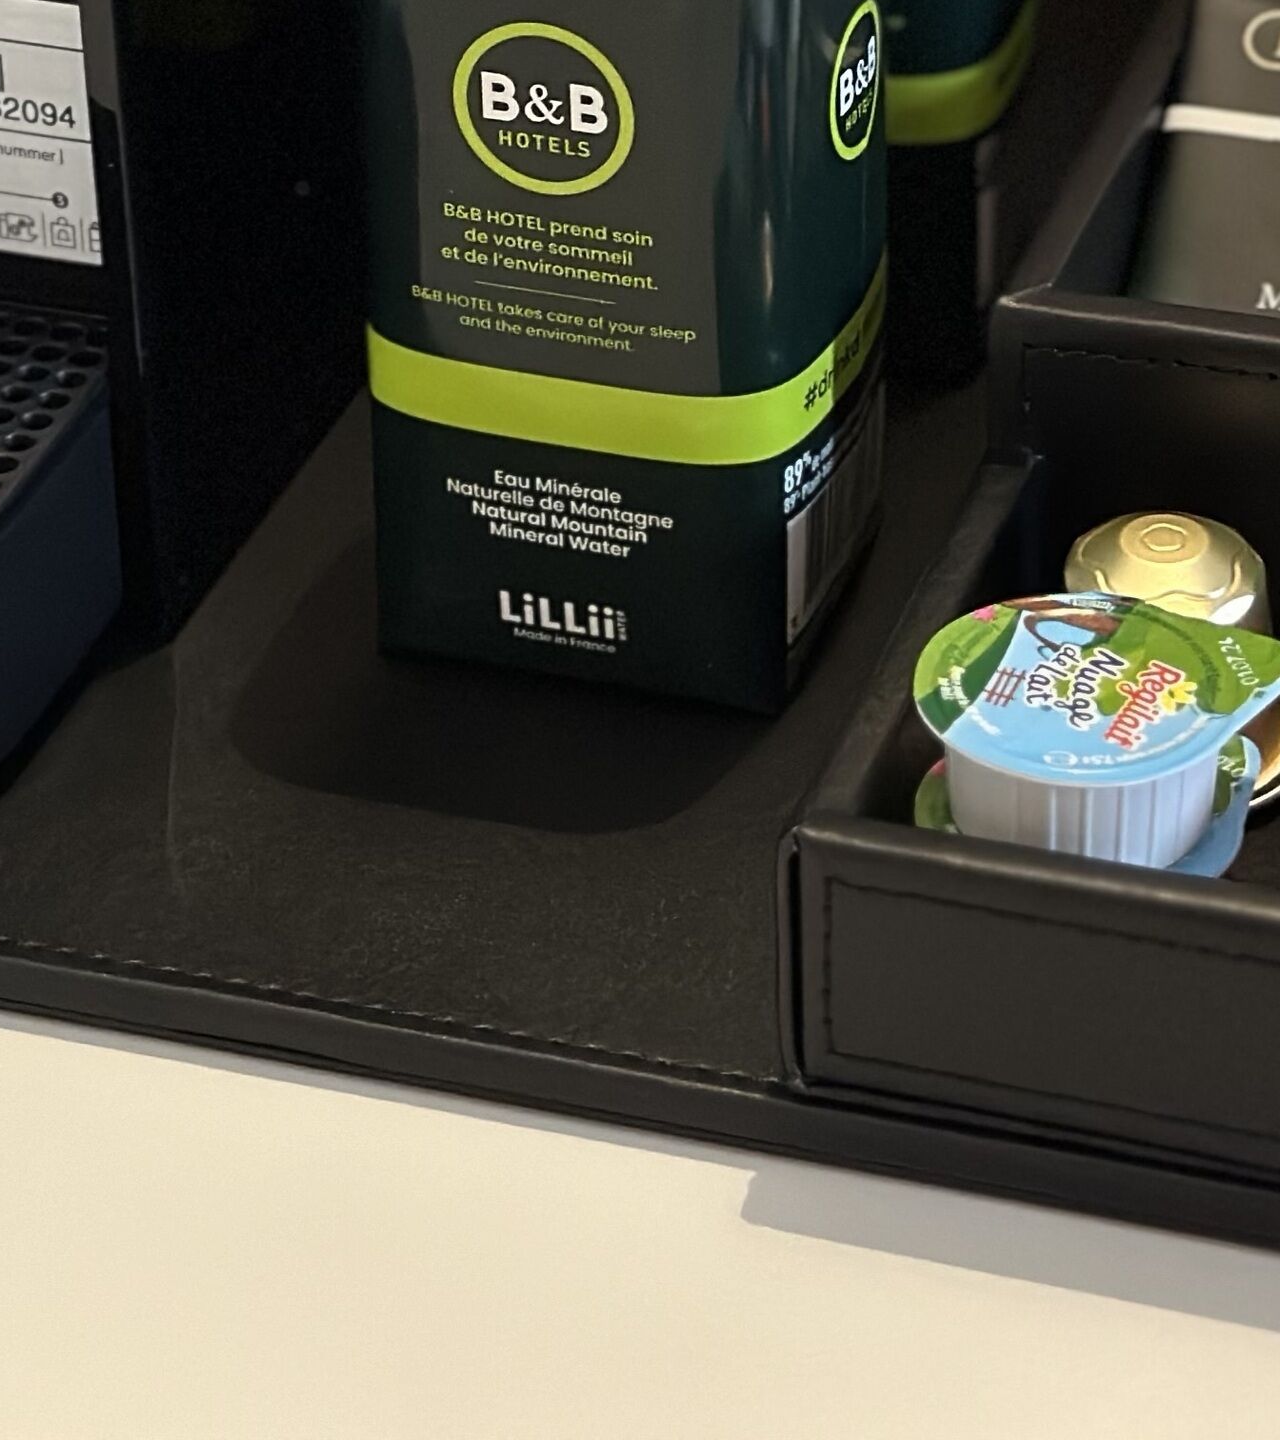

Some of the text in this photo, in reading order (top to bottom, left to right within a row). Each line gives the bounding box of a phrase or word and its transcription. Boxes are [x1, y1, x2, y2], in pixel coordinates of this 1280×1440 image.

[839, 35, 876, 117] B&B
[480, 70, 609, 135] B&B
[498, 129, 592, 158] HOTELS
[443, 202, 654, 248] B&B HOTEL prend soin
[464, 227, 634, 267] de votre sommeil
[441, 245, 659, 291] et de l'environnement.
[411, 284, 697, 344] B&B HOTEL takes care of your sleep
[459, 314, 492, 331] and
[495, 318, 522, 336] the
[447, 477, 674, 530] Naturelle de Montagne
[493, 469, 622, 504] Eau Minérale
[472, 500, 648, 544] Natural Mountain
[490, 521, 631, 558] Mineral Water
[513, 626, 617, 654] Made in France
[1026, 646, 1081, 704] de Lait
[1053, 649, 1125, 729] Nuage
[1103, 660, 1182, 749] Regilait
